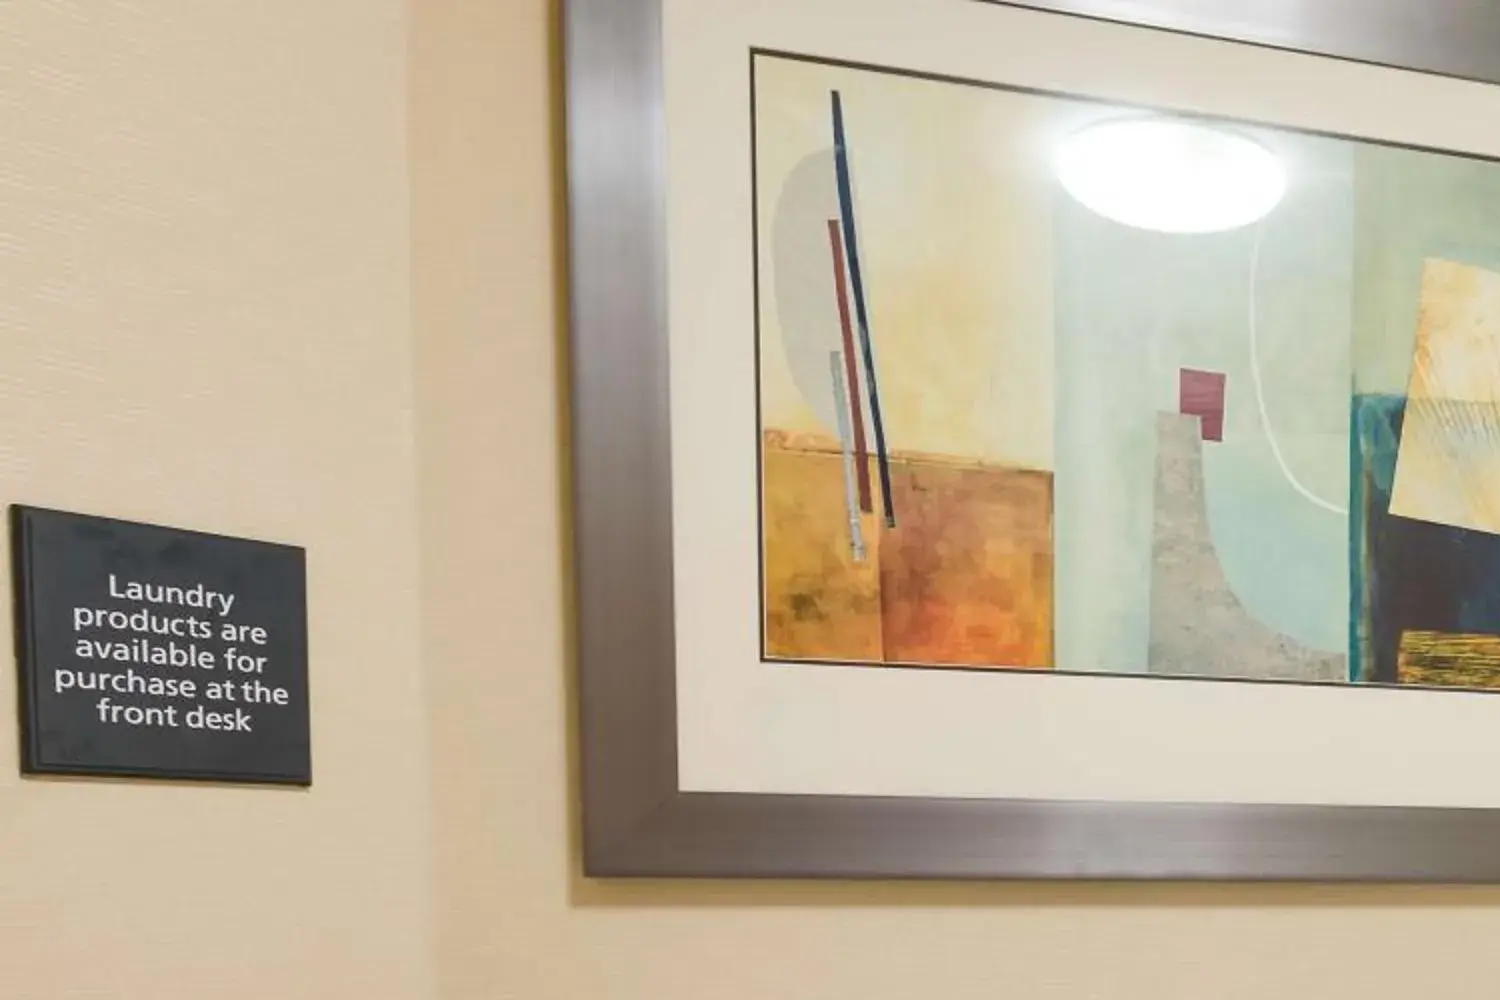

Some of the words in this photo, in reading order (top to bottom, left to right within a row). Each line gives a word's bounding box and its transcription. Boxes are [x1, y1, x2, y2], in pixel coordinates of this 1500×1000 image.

[108, 573, 235, 617] Laundry
[73, 606, 212, 640] products
[221, 623, 268, 646] are
[75, 638, 215, 670] available
[223, 647, 268, 674] for
[54, 667, 197, 698] purchase
[205, 680, 235, 702] at
[243, 680, 289, 705] the
[96, 697, 178, 728] front
[186, 705, 252, 732] desk
